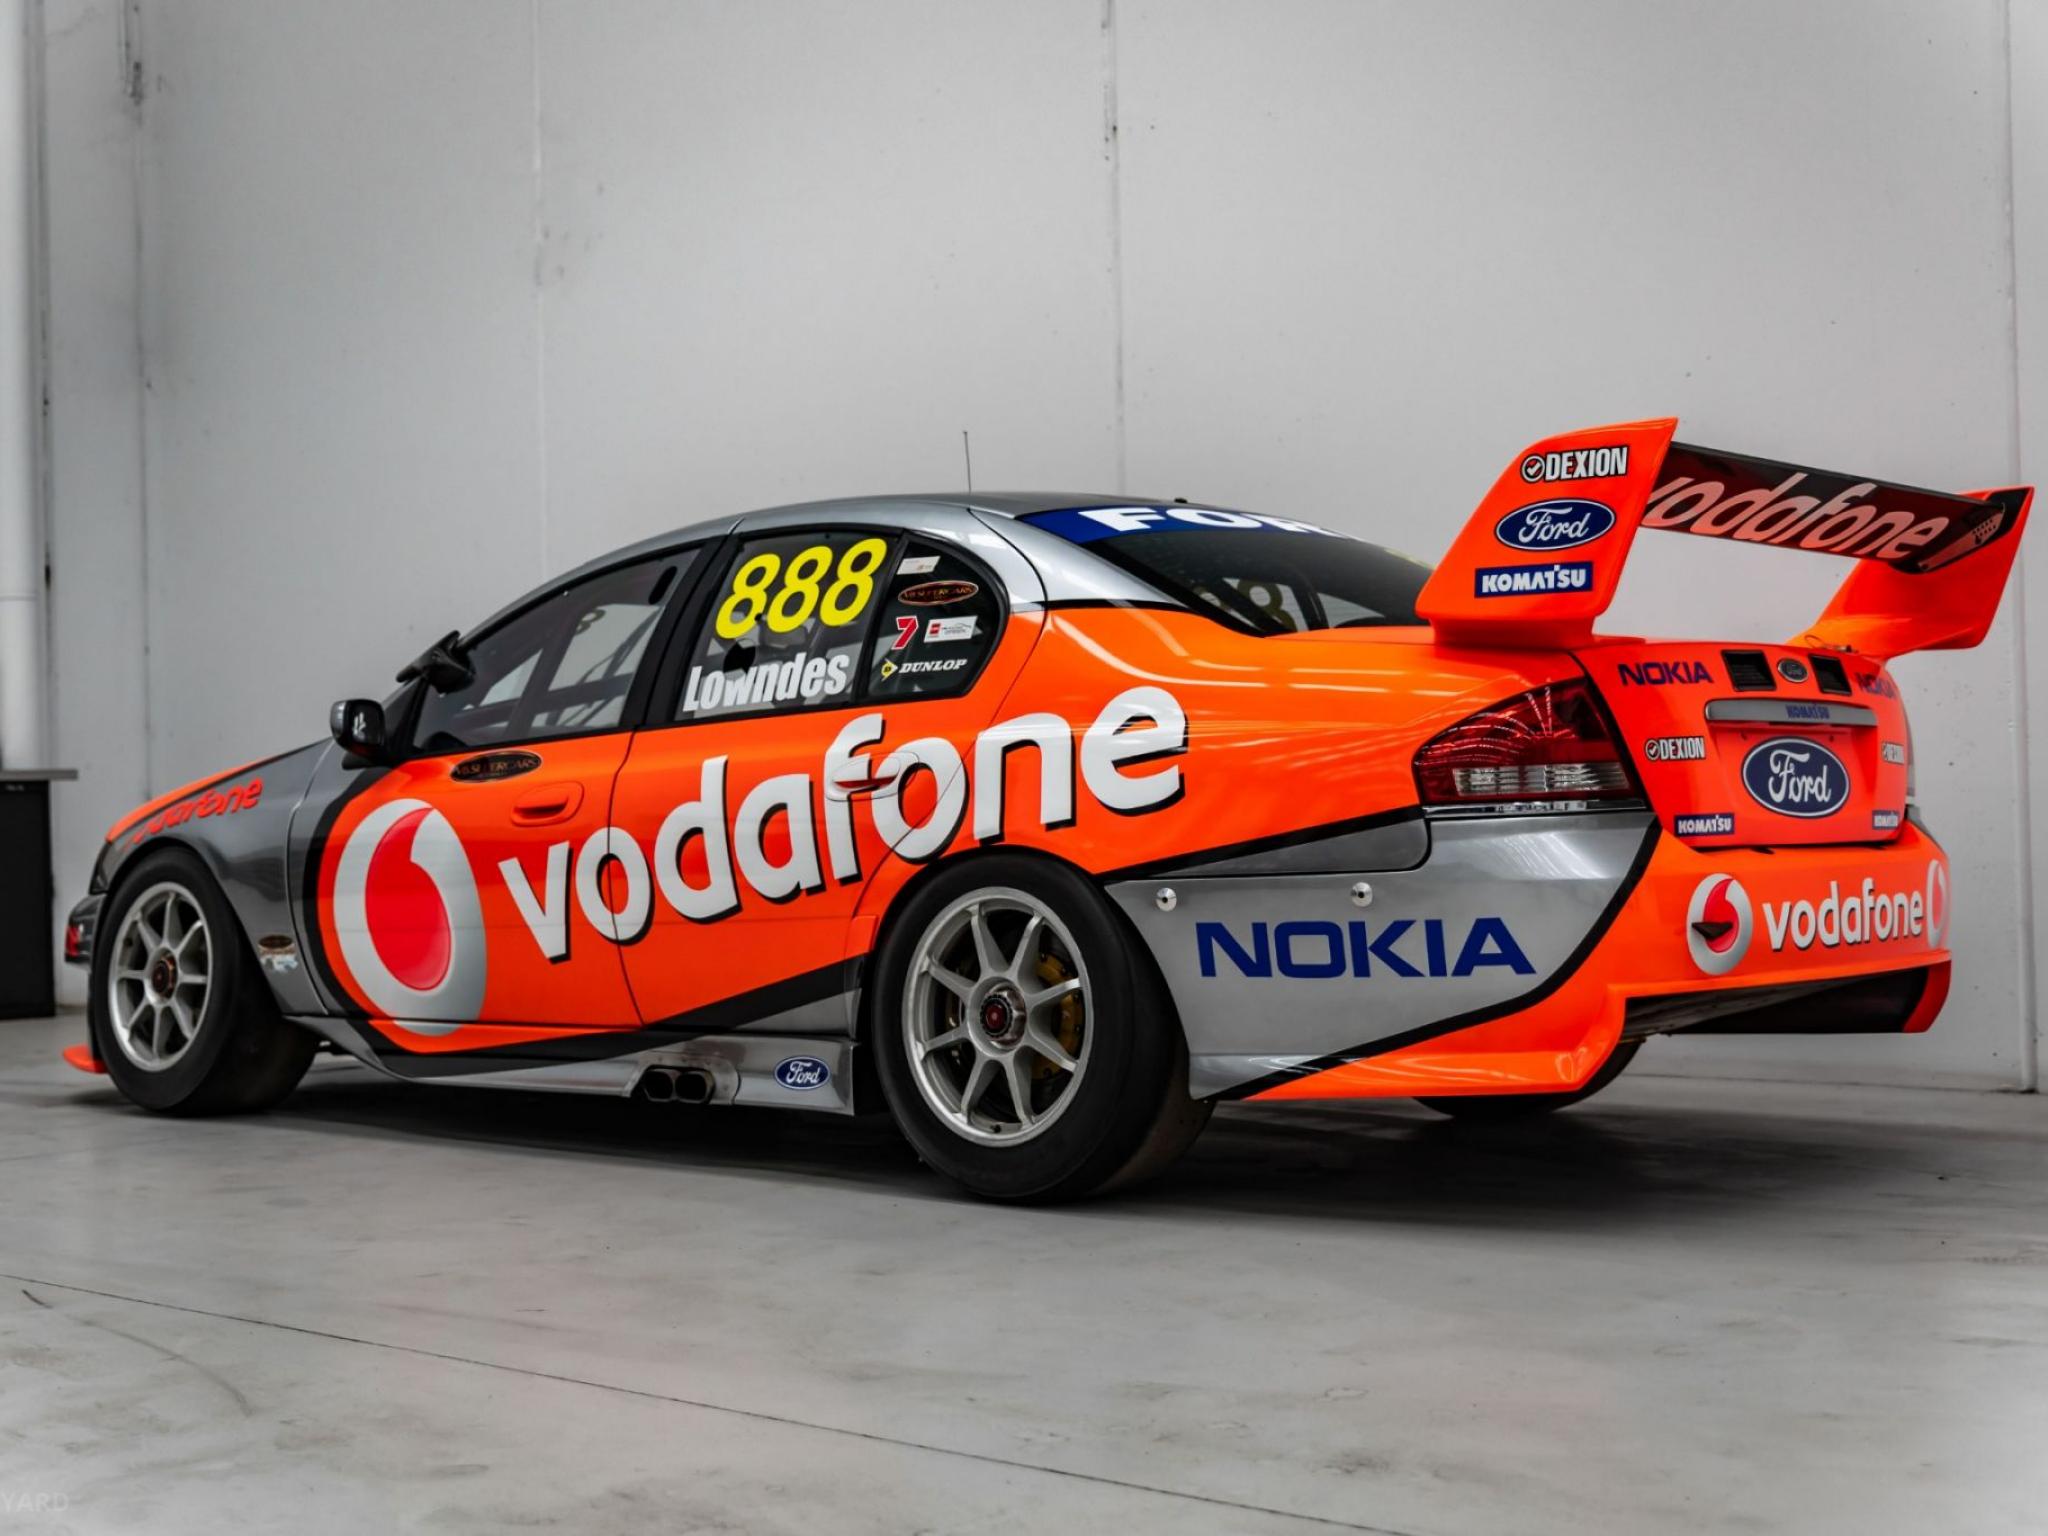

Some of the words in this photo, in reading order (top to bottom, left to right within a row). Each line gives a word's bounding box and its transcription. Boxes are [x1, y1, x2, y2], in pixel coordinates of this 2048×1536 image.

[1545, 447, 1628, 481] DEXION
[1078, 507, 1352, 539] FOR
[1518, 507, 1592, 543] Ford
[715, 538, 887, 639] 888
[1482, 564, 1587, 593] KOMATSU
[890, 615, 919, 650] 7
[683, 652, 849, 712] Lowndes
[899, 658, 968, 674] DUNLOP
[1617, 661, 1714, 686] NOKIA
[1660, 738, 1705, 760] DEXION
[1768, 750, 1831, 803] Ford
[498, 685, 1187, 963] vodafone
[1677, 815, 1732, 834] KOMATSU
[1762, 877, 1924, 951] vodafone
[1195, 917, 1538, 979] NOKIA
[785, 1060, 822, 1084] Ford
